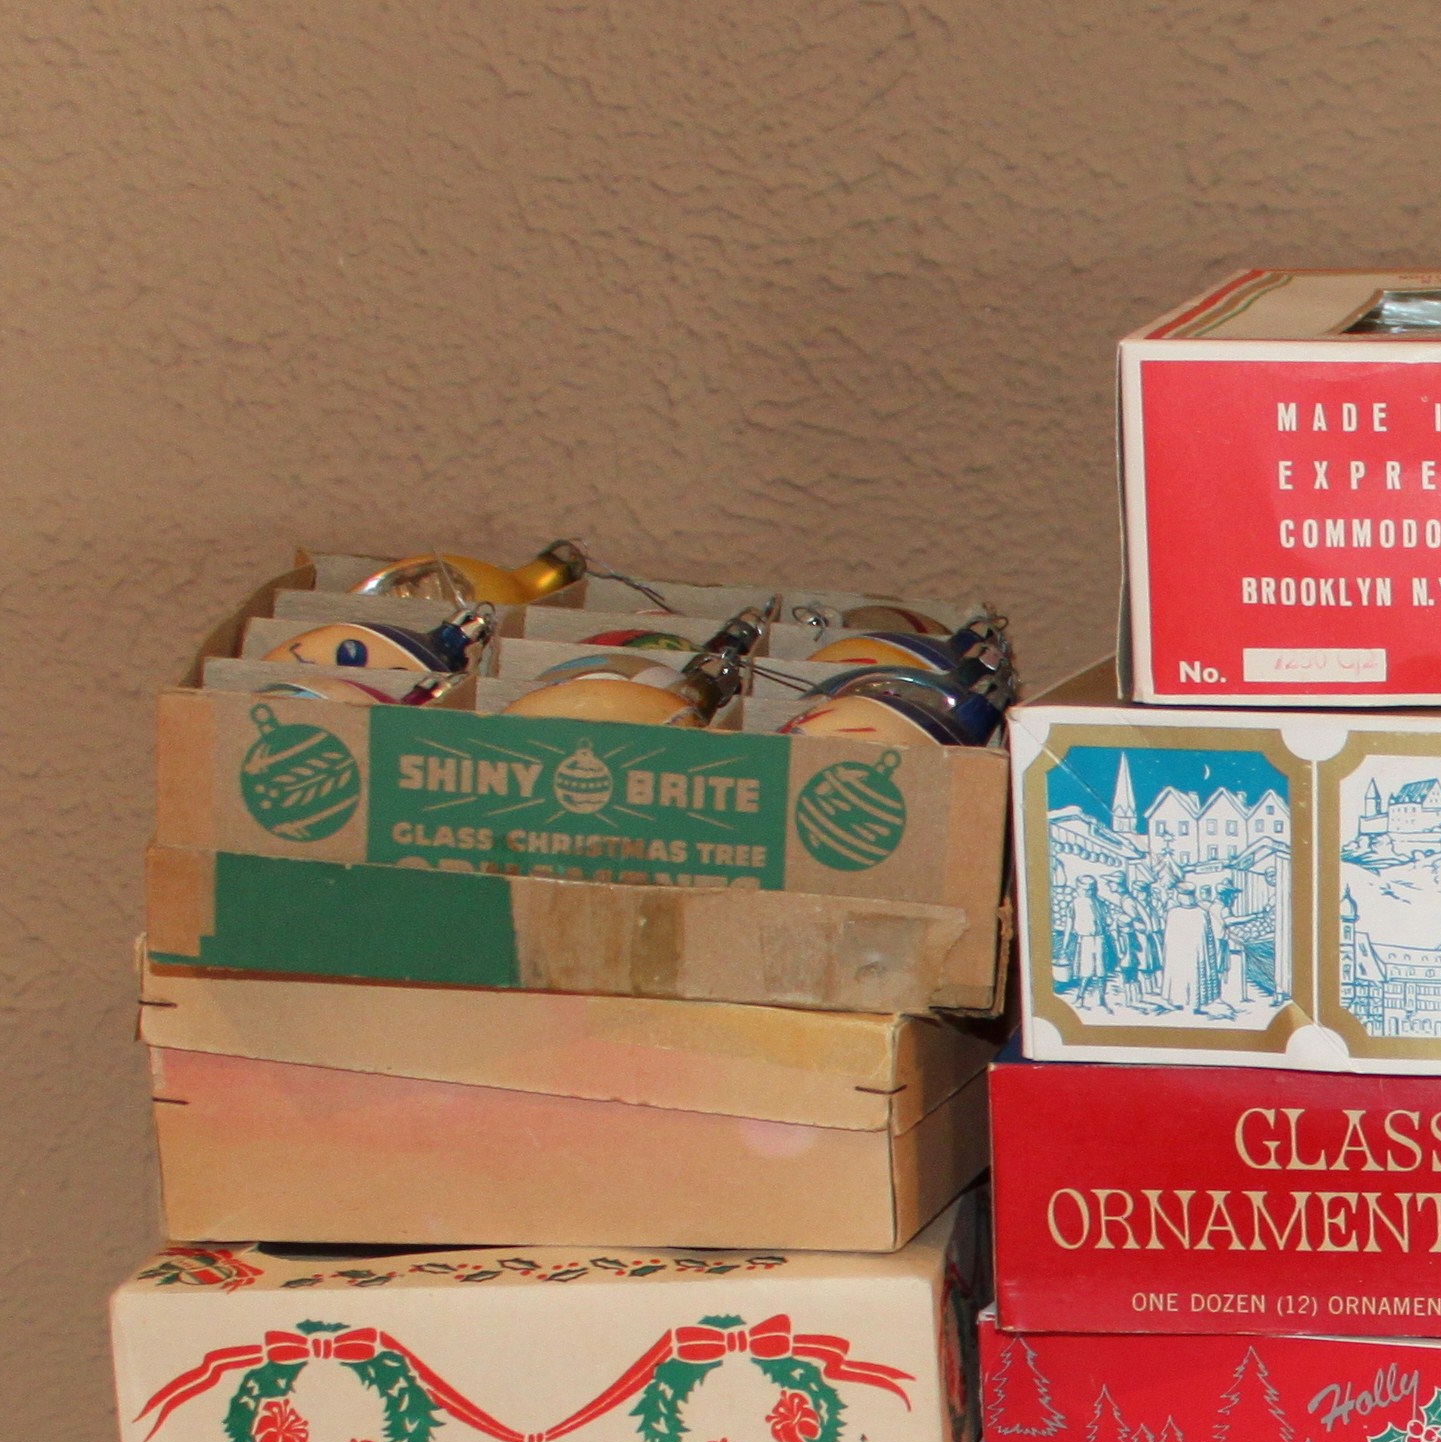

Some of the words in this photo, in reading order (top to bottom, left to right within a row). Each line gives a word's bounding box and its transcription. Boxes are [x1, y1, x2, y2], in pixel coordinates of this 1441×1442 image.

[1277, 402, 1390, 435] MADE
[1242, 577, 1392, 607] BROOKLYN
[1179, 661, 1227, 684] No.
[398, 754, 542, 796] SHINY
[626, 771, 760, 813] BRITE
[392, 821, 493, 851] GLASS
[506, 829, 687, 862] CHRISTMAS
[696, 842, 766, 867] TREE
[1131, 1291, 1181, 1313] ONE
[1189, 1292, 1267, 1315] DOZEN
[1276, 1294, 1319, 1317] (12)
[1307, 1364, 1420, 1432] Holly
